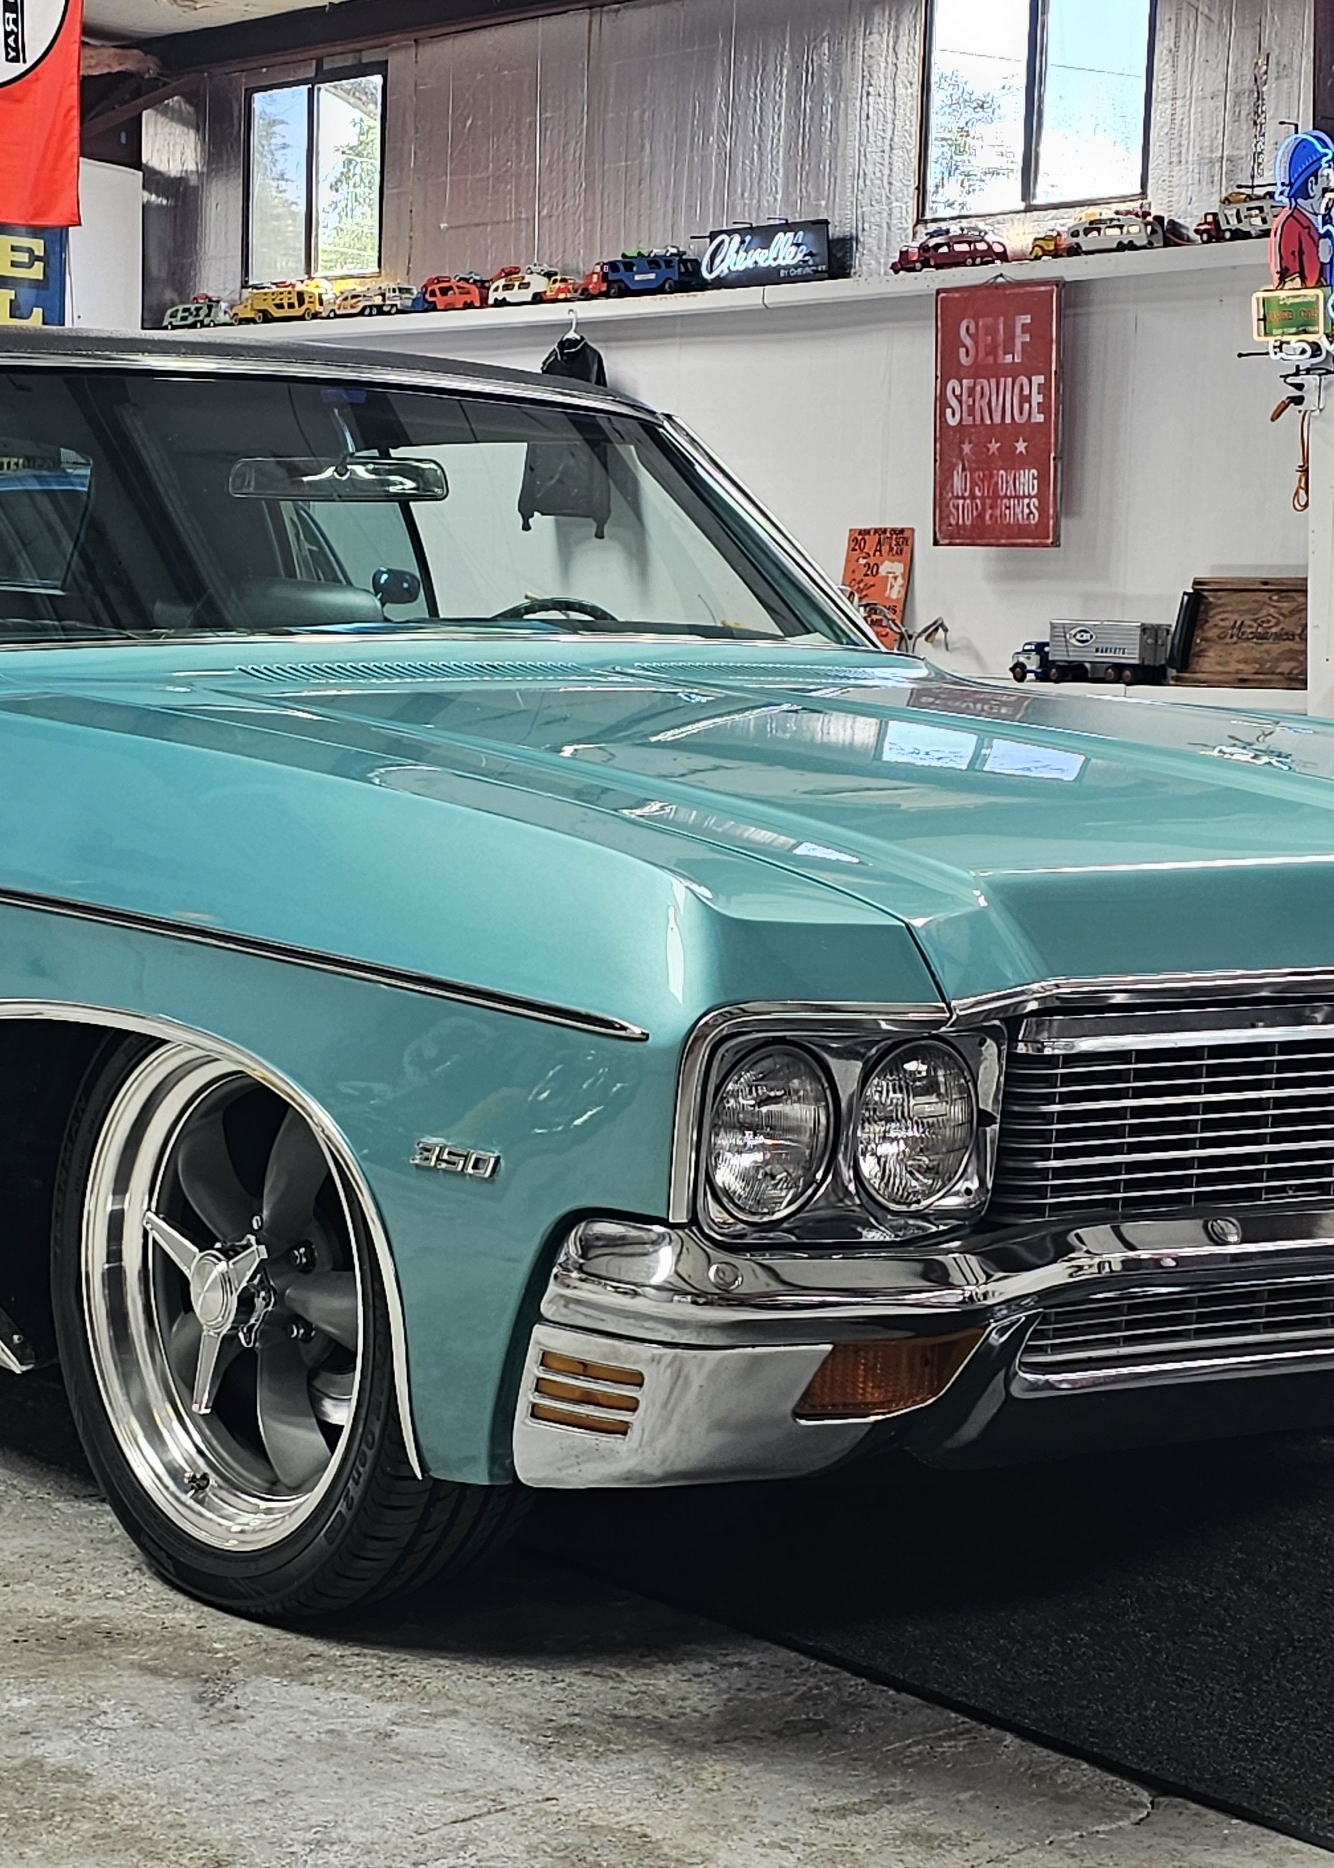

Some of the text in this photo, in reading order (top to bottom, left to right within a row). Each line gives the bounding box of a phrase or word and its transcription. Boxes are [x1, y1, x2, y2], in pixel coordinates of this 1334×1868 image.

[701, 231, 814, 280] Chevelle
[959, 315, 1031, 366] SELF
[945, 375, 1045, 426] SERVICE
[953, 469, 968, 497] NO
[863, 562, 879, 577] 20
[410, 1140, 502, 1178] 350
